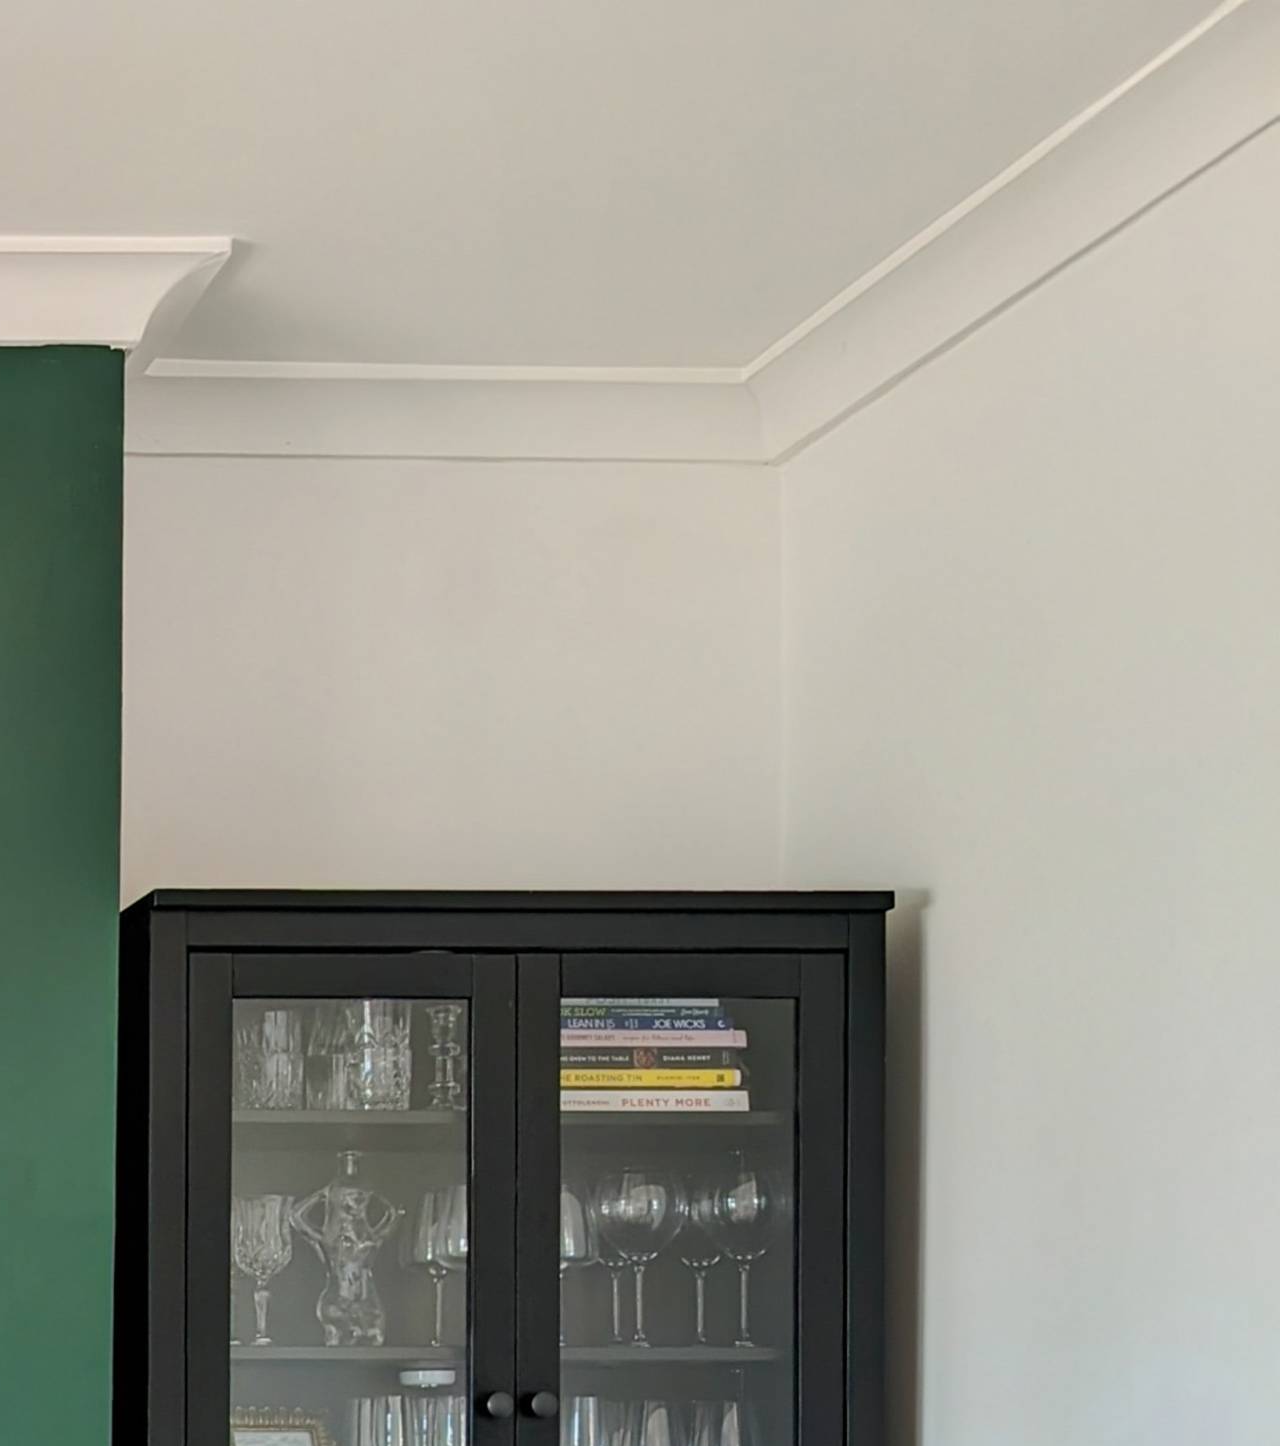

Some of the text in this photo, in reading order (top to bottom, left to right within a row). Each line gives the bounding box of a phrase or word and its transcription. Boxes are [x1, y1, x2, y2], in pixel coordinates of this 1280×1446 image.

[574, 1007, 607, 1016] SLOW
[567, 1019, 592, 1028] LEAN
[594, 1019, 604, 1028] IN
[652, 1019, 671, 1028] JOE
[674, 1019, 706, 1028] WICKS
[622, 1098, 670, 1107] PLENTY
[675, 1098, 711, 1107] MORE
